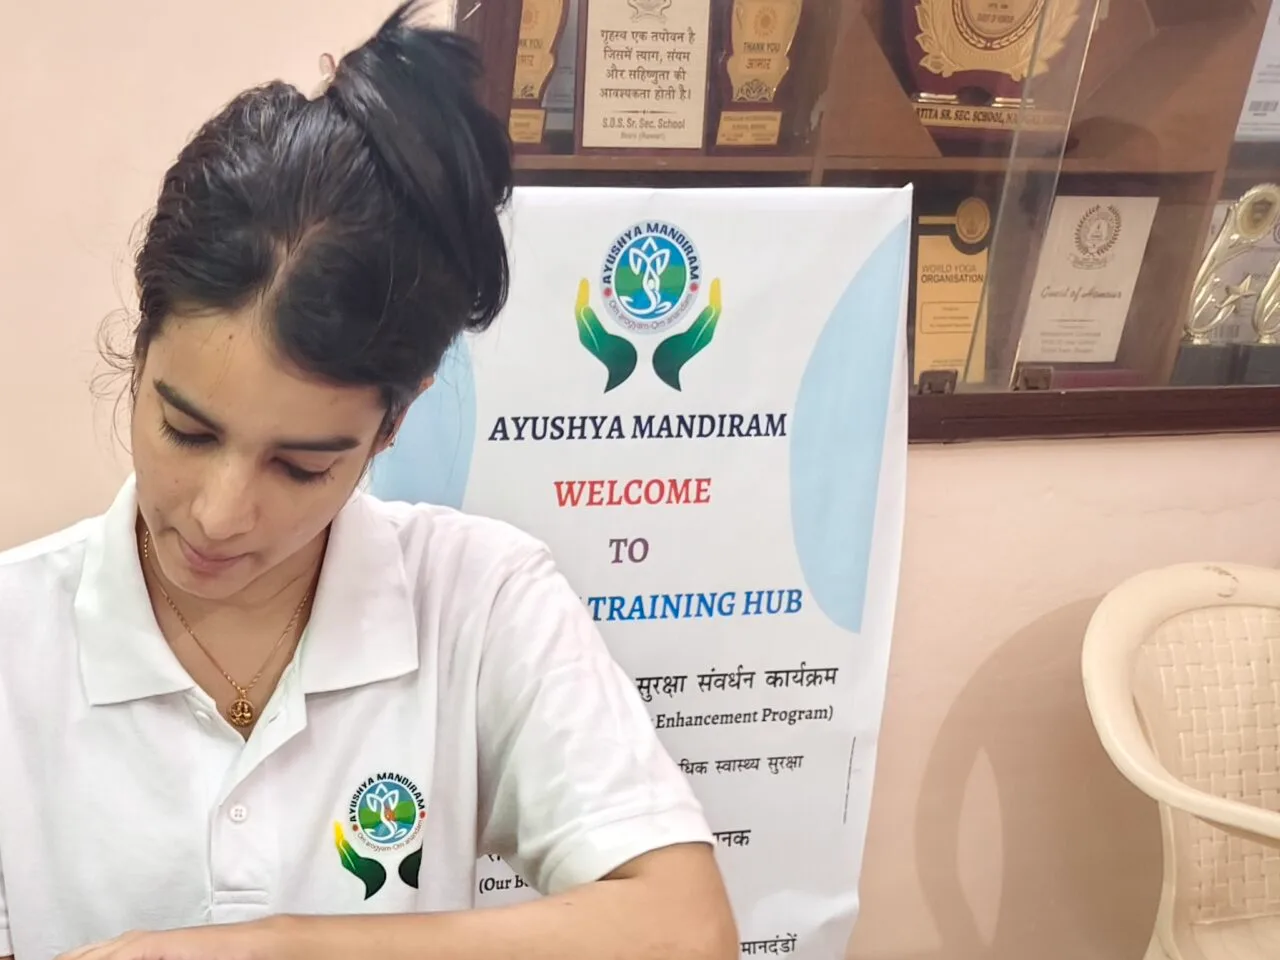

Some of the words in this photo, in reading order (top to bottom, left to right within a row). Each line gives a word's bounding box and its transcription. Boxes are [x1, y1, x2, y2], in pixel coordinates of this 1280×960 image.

[631, 30, 648, 43] एक
[651, 28, 685, 42] तपोवन
[688, 26, 696, 45] है
[603, 45, 632, 60] जिसमें
[667, 48, 691, 61] संयम
[606, 63, 626, 79] और
[673, 66, 687, 80] की
[654, 84, 676, 101] होती
[658, 117, 685, 129] School
[603, 226, 642, 284] AYUSHYA
[647, 222, 699, 280] MANDIRAM
[920, 274, 984, 284] ORGANISATION
[921, 264, 952, 273] WORLD
[954, 264, 977, 273] YOGA
[488, 415, 626, 441] AYUSHYA
[632, 412, 787, 439] MANDIRAM
[553, 477, 712, 508] WELCOME
[608, 537, 649, 564] TO
[587, 591, 736, 622] TRAINING
[742, 588, 803, 615] HUB
[635, 674, 688, 702] सुरक्षा
[697, 664, 756, 692] संवर्धन
[764, 661, 839, 688] कार्यक्रम
[655, 711, 758, 729] Enhancement
[762, 705, 834, 726] Program)
[715, 757, 761, 774] स्वास्थ्य
[767, 755, 804, 774] सुरक्षा
[349, 777, 375, 822] AYUSHYA
[377, 772, 425, 810] MANDIRAM
[479, 876, 512, 894] (Our
[740, 932, 797, 955] मानदंडों
